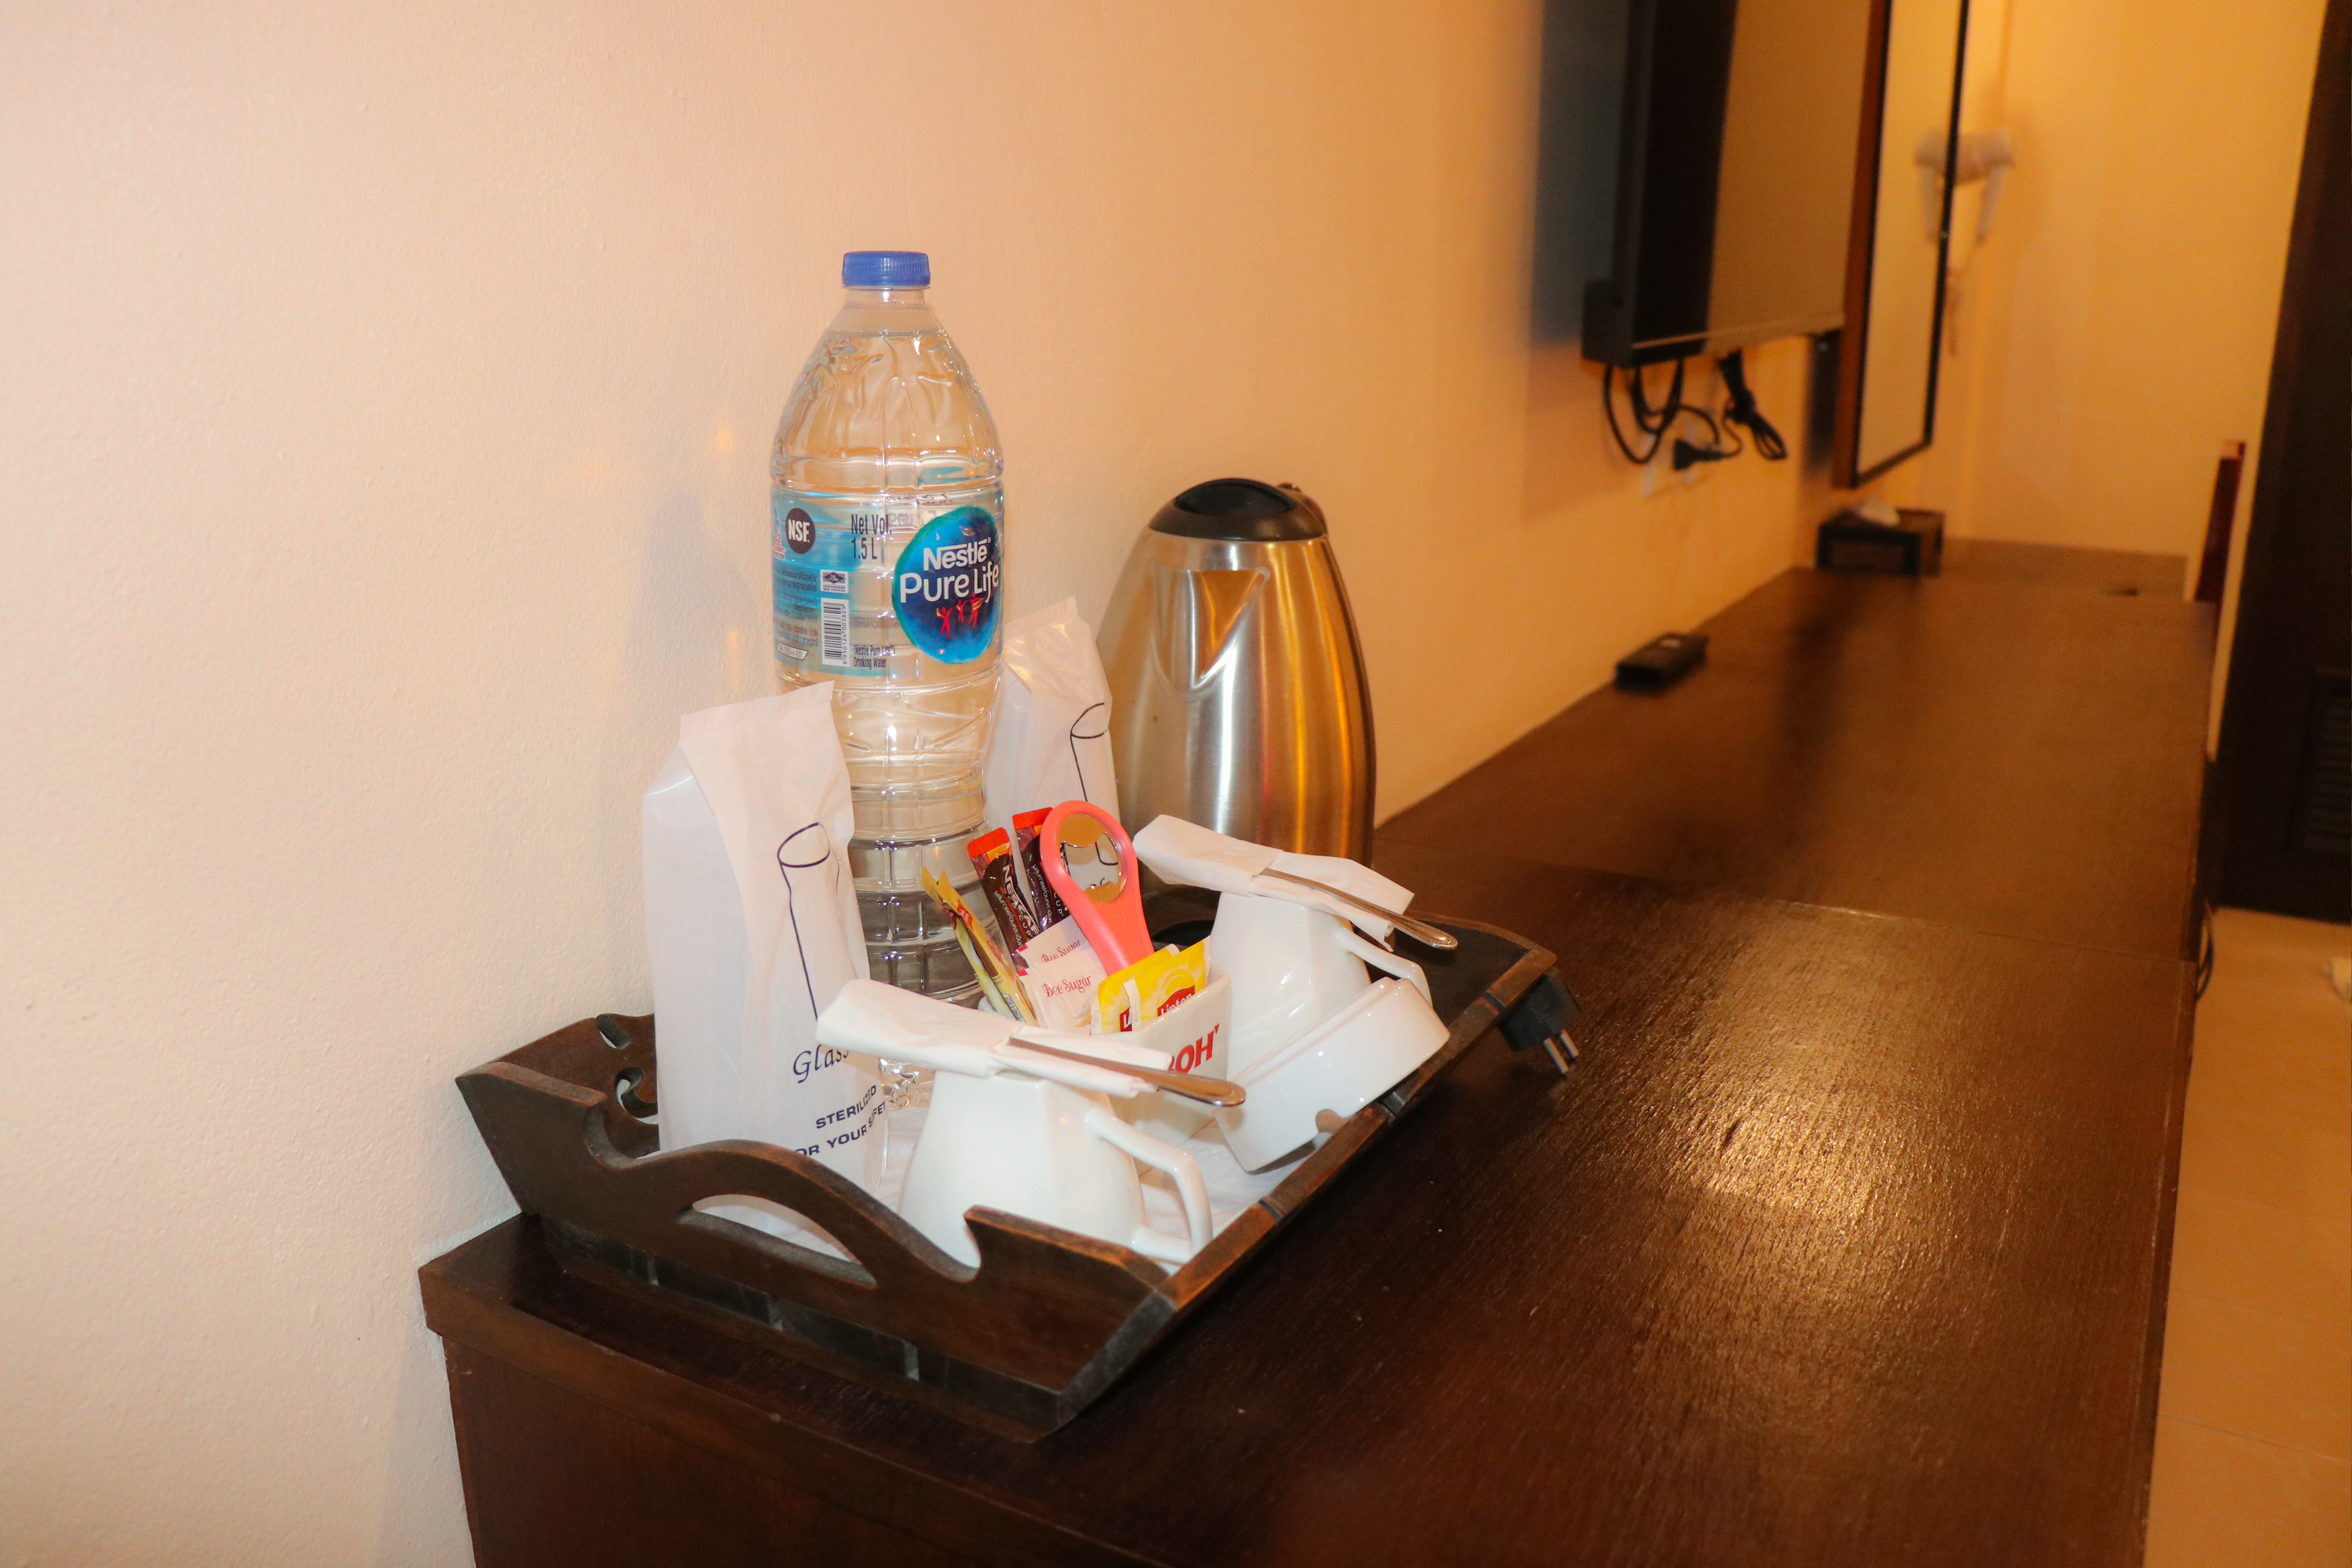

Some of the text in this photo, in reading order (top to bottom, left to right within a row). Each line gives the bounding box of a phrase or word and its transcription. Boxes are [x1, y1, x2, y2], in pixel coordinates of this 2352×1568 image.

[851, 514, 892, 535] Net Vol.
[851, 536, 877, 559] 1.5 L
[900, 561, 999, 603] Pure Life
[854, 656, 886, 670] Drinking Water
[1002, 864, 1041, 935] NESCAF
[1018, 915, 1032, 936] CUP
[1042, 976, 1091, 998] Bee Sugar
[816, 1085, 877, 1129] STERILIZED
[795, 1101, 886, 1156] OR YOUR SFET
